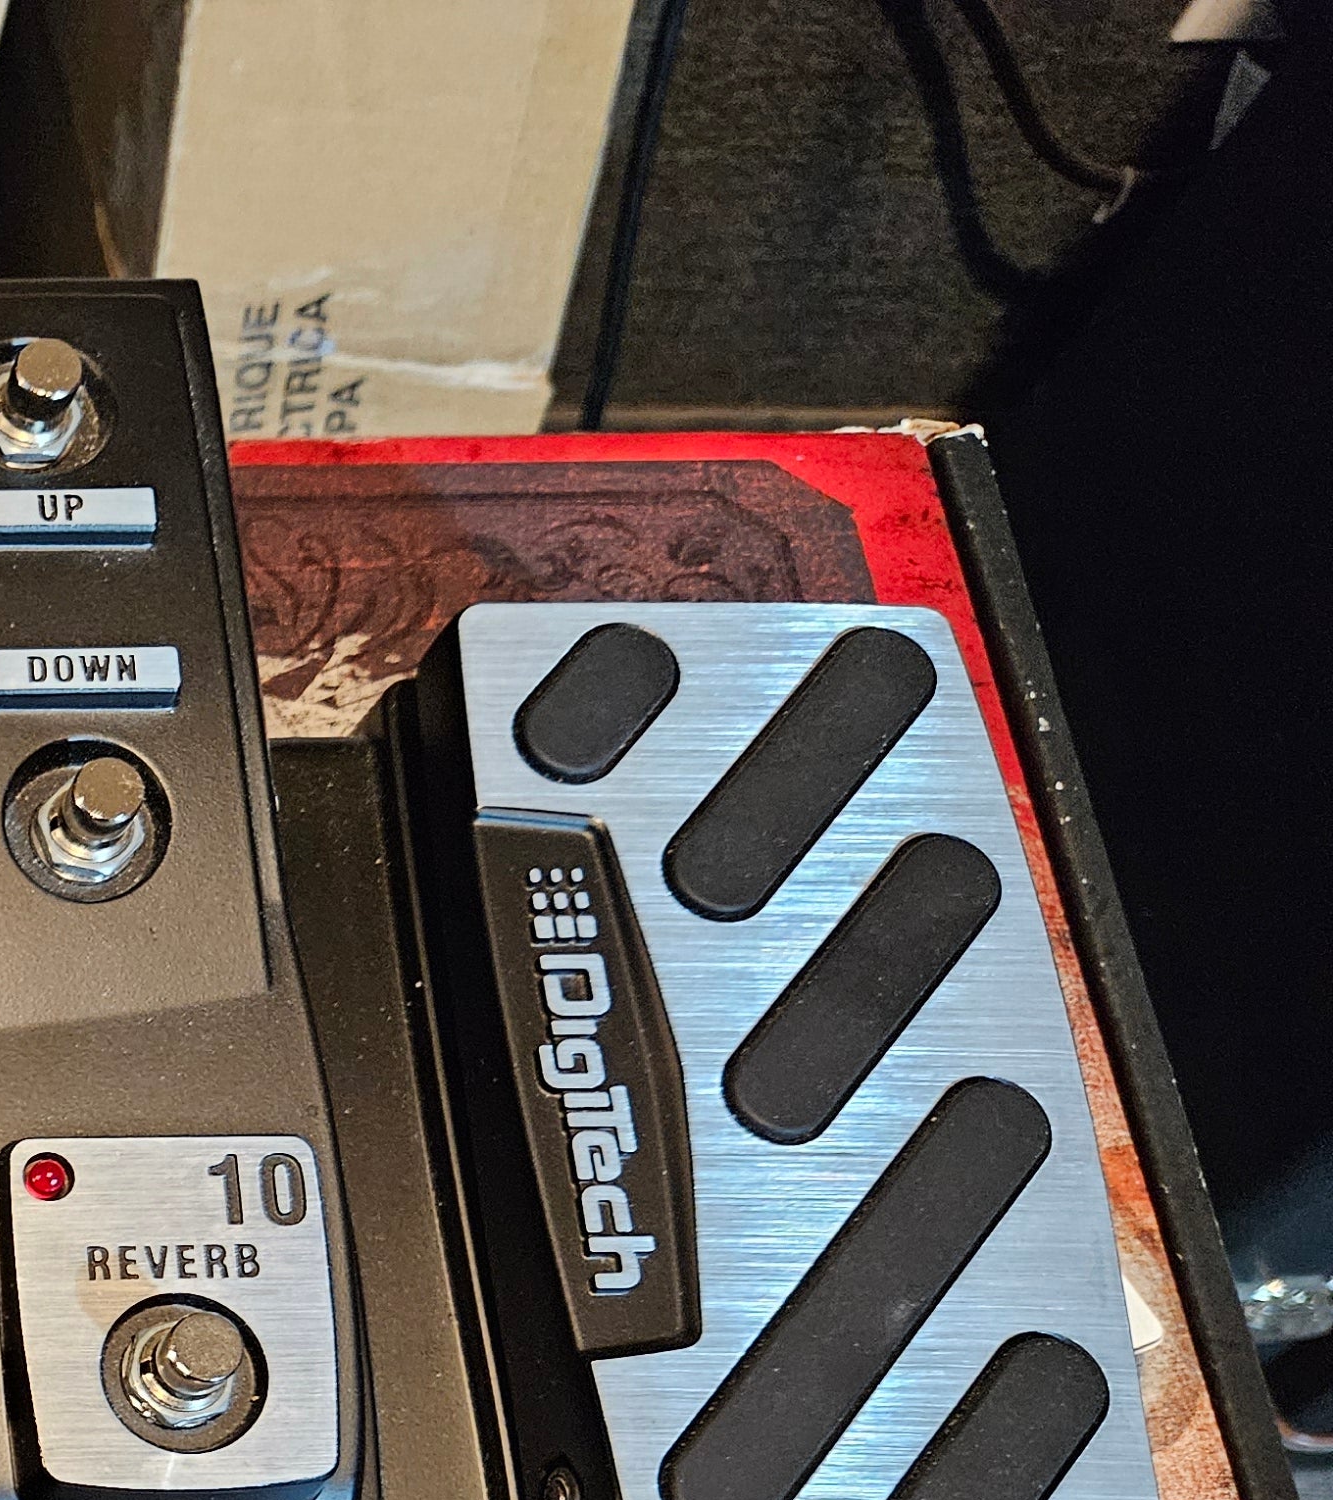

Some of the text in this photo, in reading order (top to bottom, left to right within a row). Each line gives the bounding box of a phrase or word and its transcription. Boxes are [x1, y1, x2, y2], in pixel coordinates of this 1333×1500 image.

[324, 375, 366, 434] PA
[38, 494, 84, 521] UP
[27, 654, 137, 682] DOWN
[539, 952, 655, 1290] DigiTech
[207, 1153, 307, 1226] 10
[87, 1245, 260, 1280] REVERB
